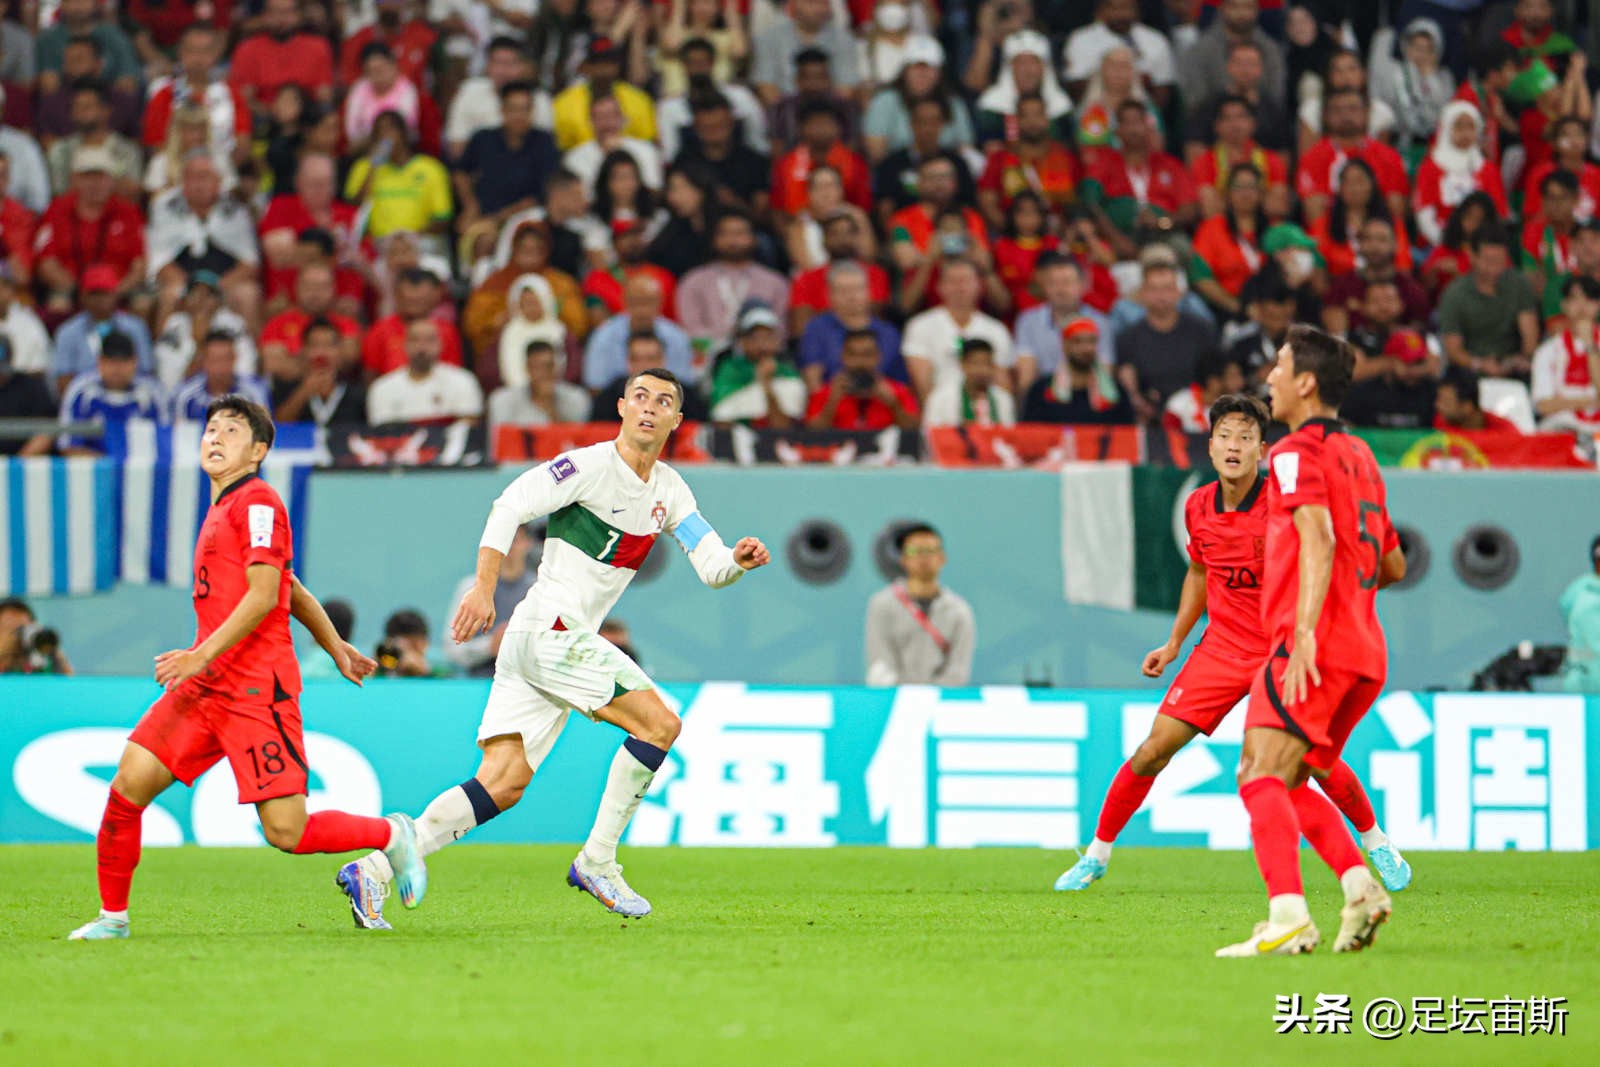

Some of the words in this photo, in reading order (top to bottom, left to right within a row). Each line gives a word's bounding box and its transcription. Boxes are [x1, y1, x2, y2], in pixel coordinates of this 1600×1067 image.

[596, 529, 620, 560] 7
[1357, 499, 1382, 589] 5
[195, 565, 210, 599] 8
[1220, 565, 1258, 589] 20
[245, 741, 285, 779] 18
